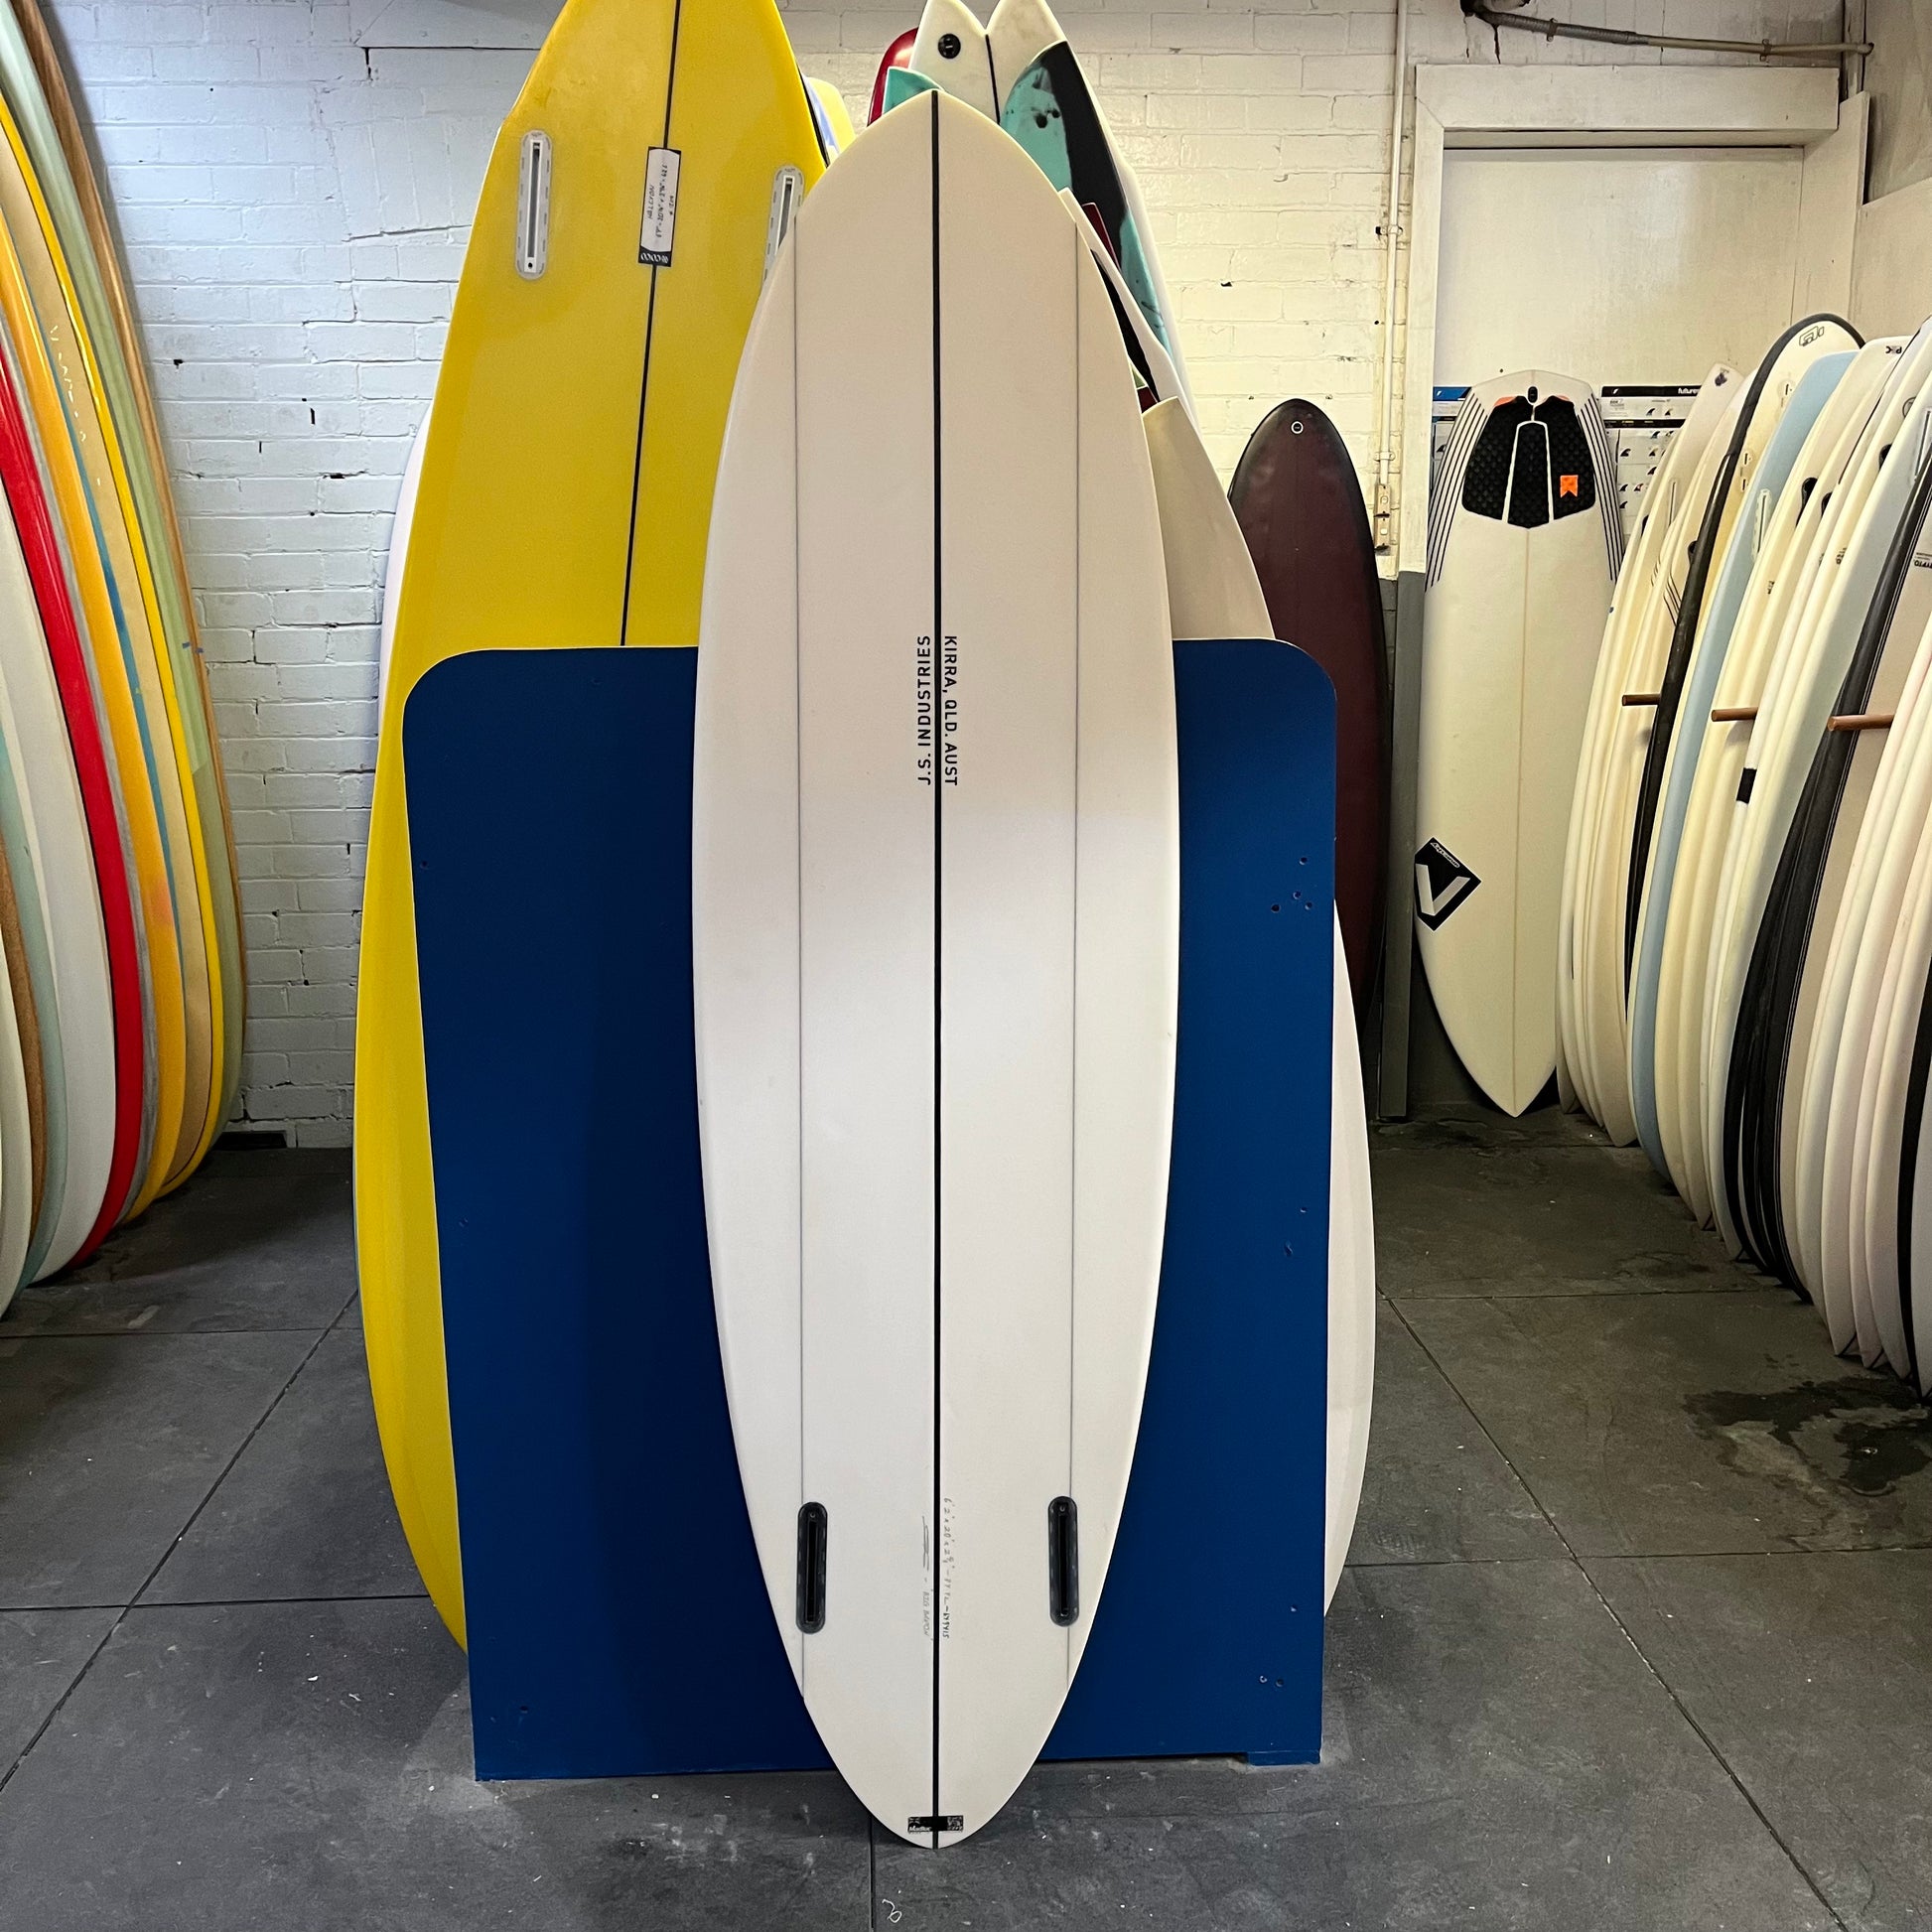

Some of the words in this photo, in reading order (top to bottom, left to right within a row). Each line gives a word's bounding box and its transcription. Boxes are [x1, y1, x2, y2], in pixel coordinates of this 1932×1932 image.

[942, 635, 957, 693] KIRRA,
[917, 635, 931, 747] INDUSTRIES
[944, 699, 957, 738] QLD.
[917, 753, 931, 786] J.S.
[944, 743, 958, 786] AUST
